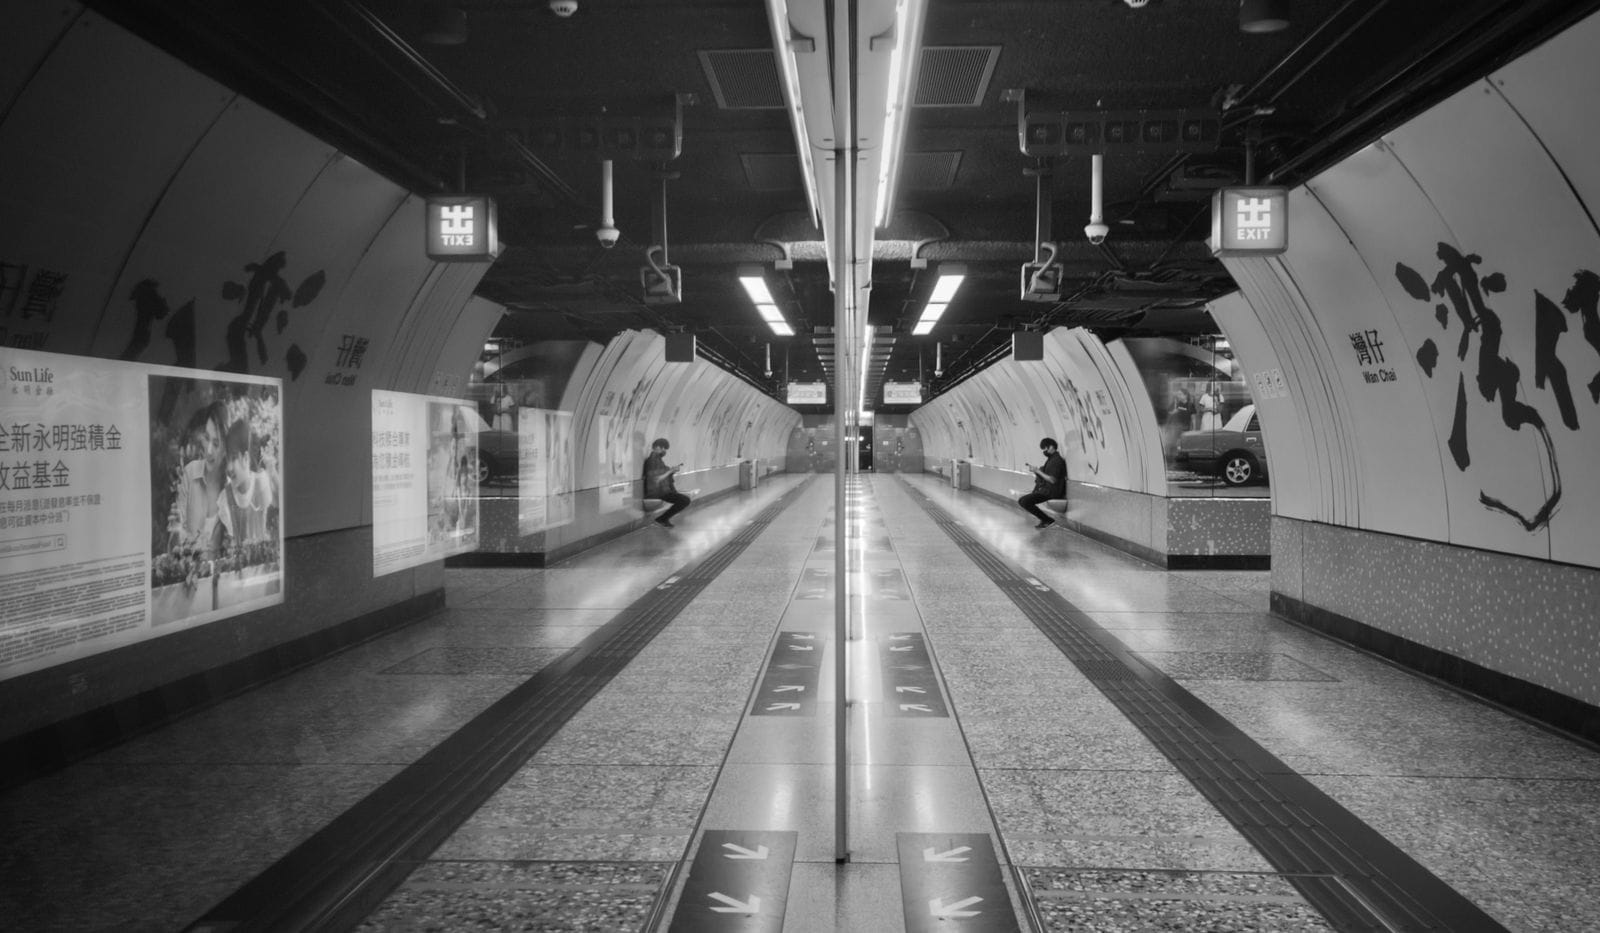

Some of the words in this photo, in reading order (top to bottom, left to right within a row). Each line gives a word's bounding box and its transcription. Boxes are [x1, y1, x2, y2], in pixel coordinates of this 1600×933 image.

[1237, 198, 1271, 227] 出
[1237, 228, 1271, 240] EXIT
[1348, 329, 1385, 366] 灣仔
[9, 366, 32, 382] Sun
[34, 367, 54, 383] Life
[1362, 371, 1380, 384] Wan
[1379, 368, 1398, 382] Chai
